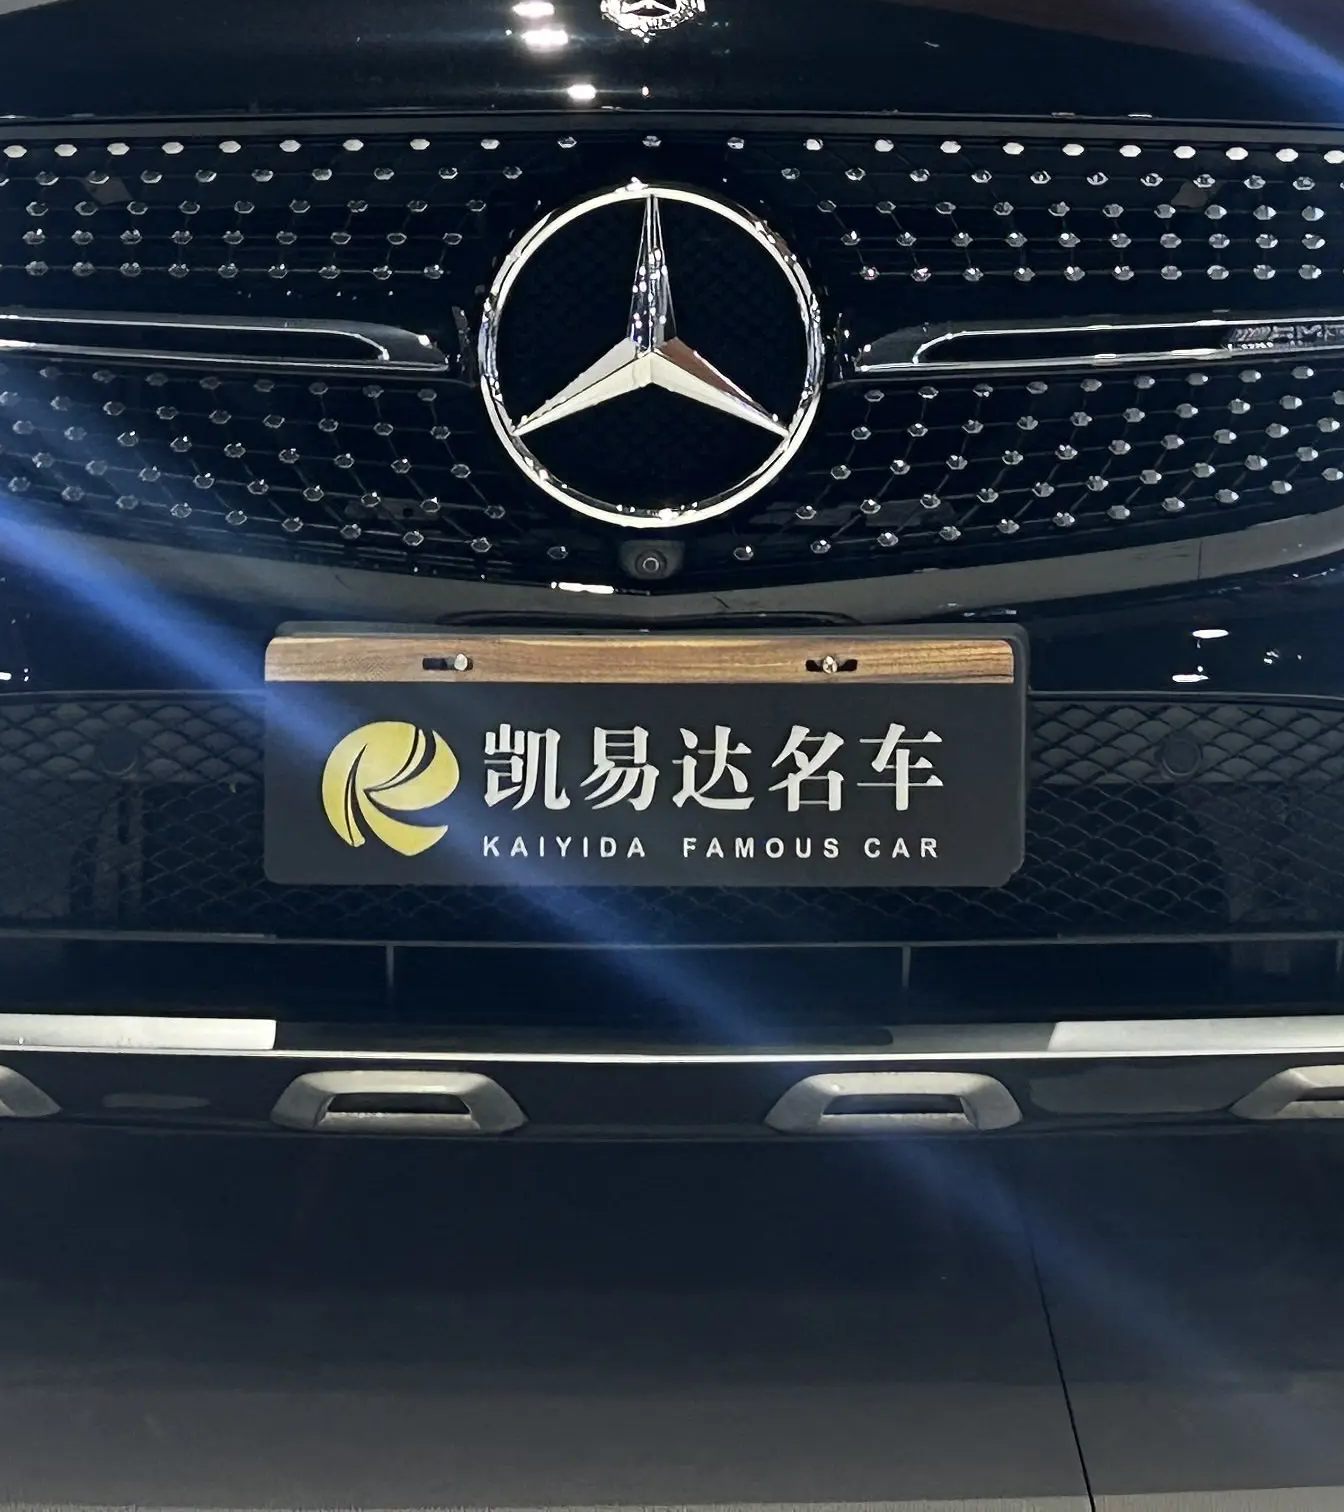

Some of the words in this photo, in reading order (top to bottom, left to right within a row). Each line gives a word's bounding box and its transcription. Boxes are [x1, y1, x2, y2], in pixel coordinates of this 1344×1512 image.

[484, 724, 943, 811] 凯易达名车
[484, 836, 645, 858] KAIYIDA
[684, 838, 838, 858] FAMOUS
[865, 838, 937, 858] CAR
